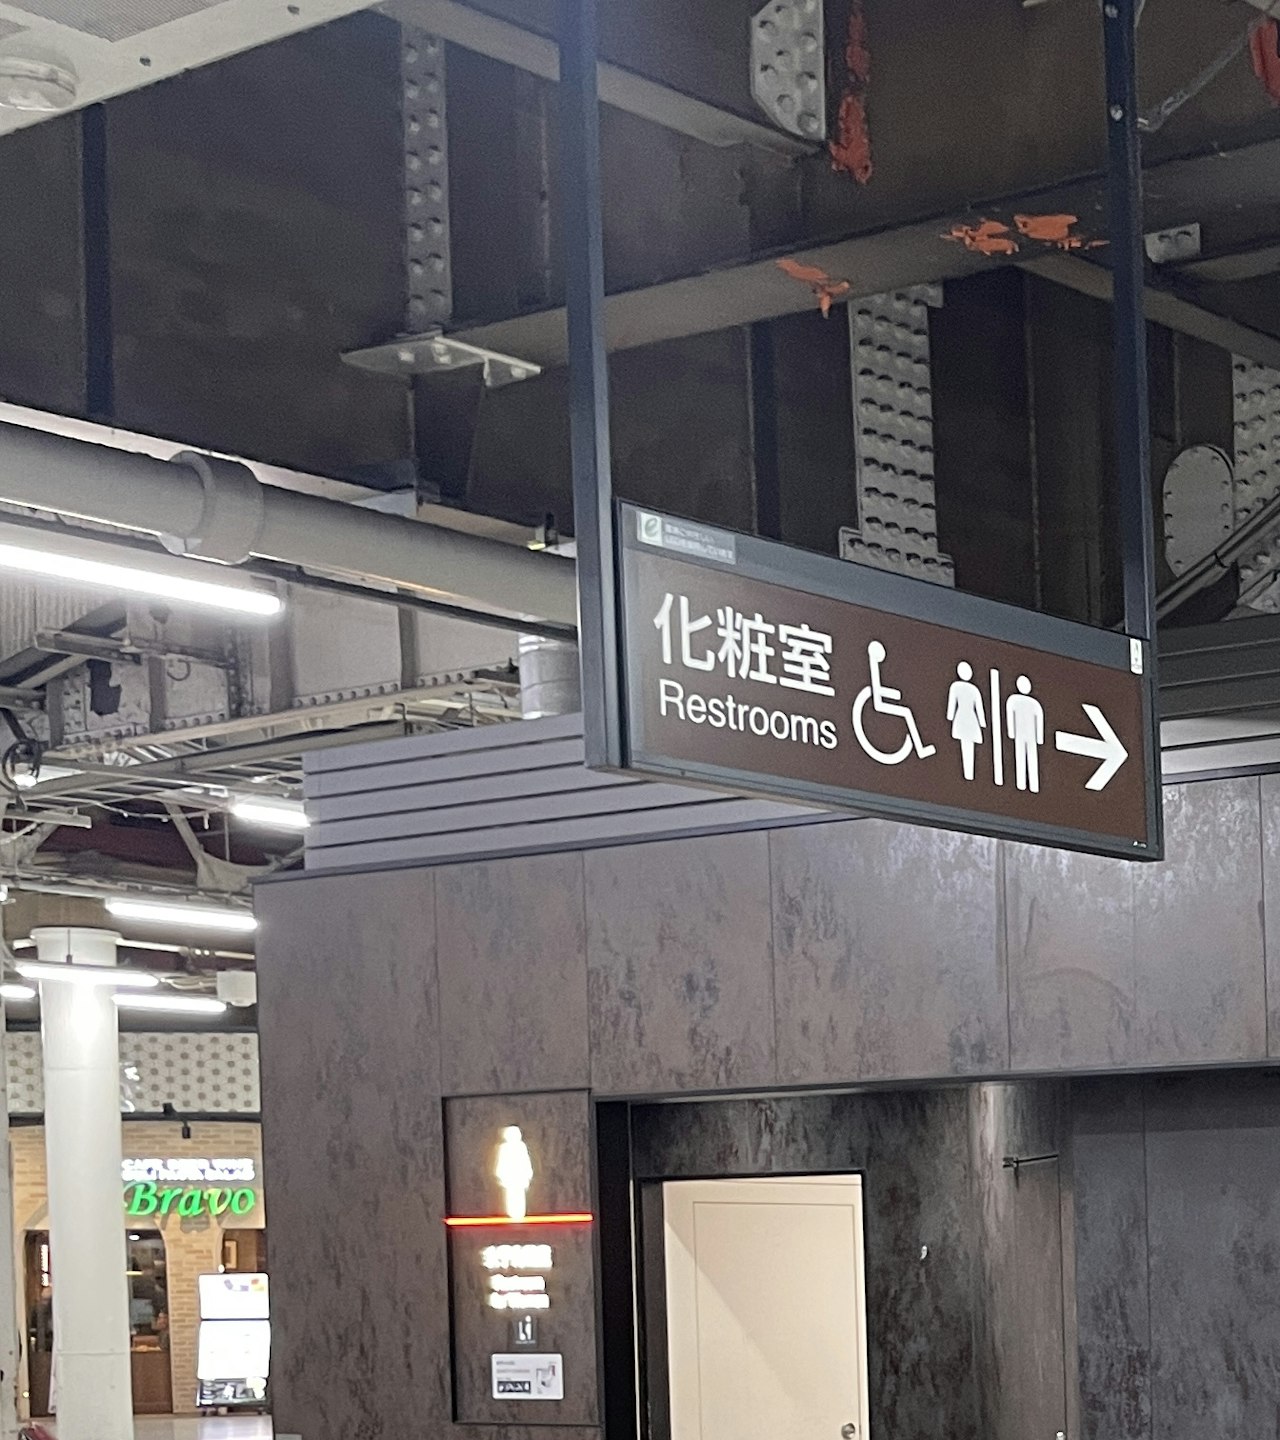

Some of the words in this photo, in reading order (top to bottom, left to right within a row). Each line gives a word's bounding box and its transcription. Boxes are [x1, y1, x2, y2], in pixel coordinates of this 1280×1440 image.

[653, 593, 836, 697] 化粧室
[659, 678, 838, 750] Restrooms
[122, 1181, 256, 1217] Bravo
